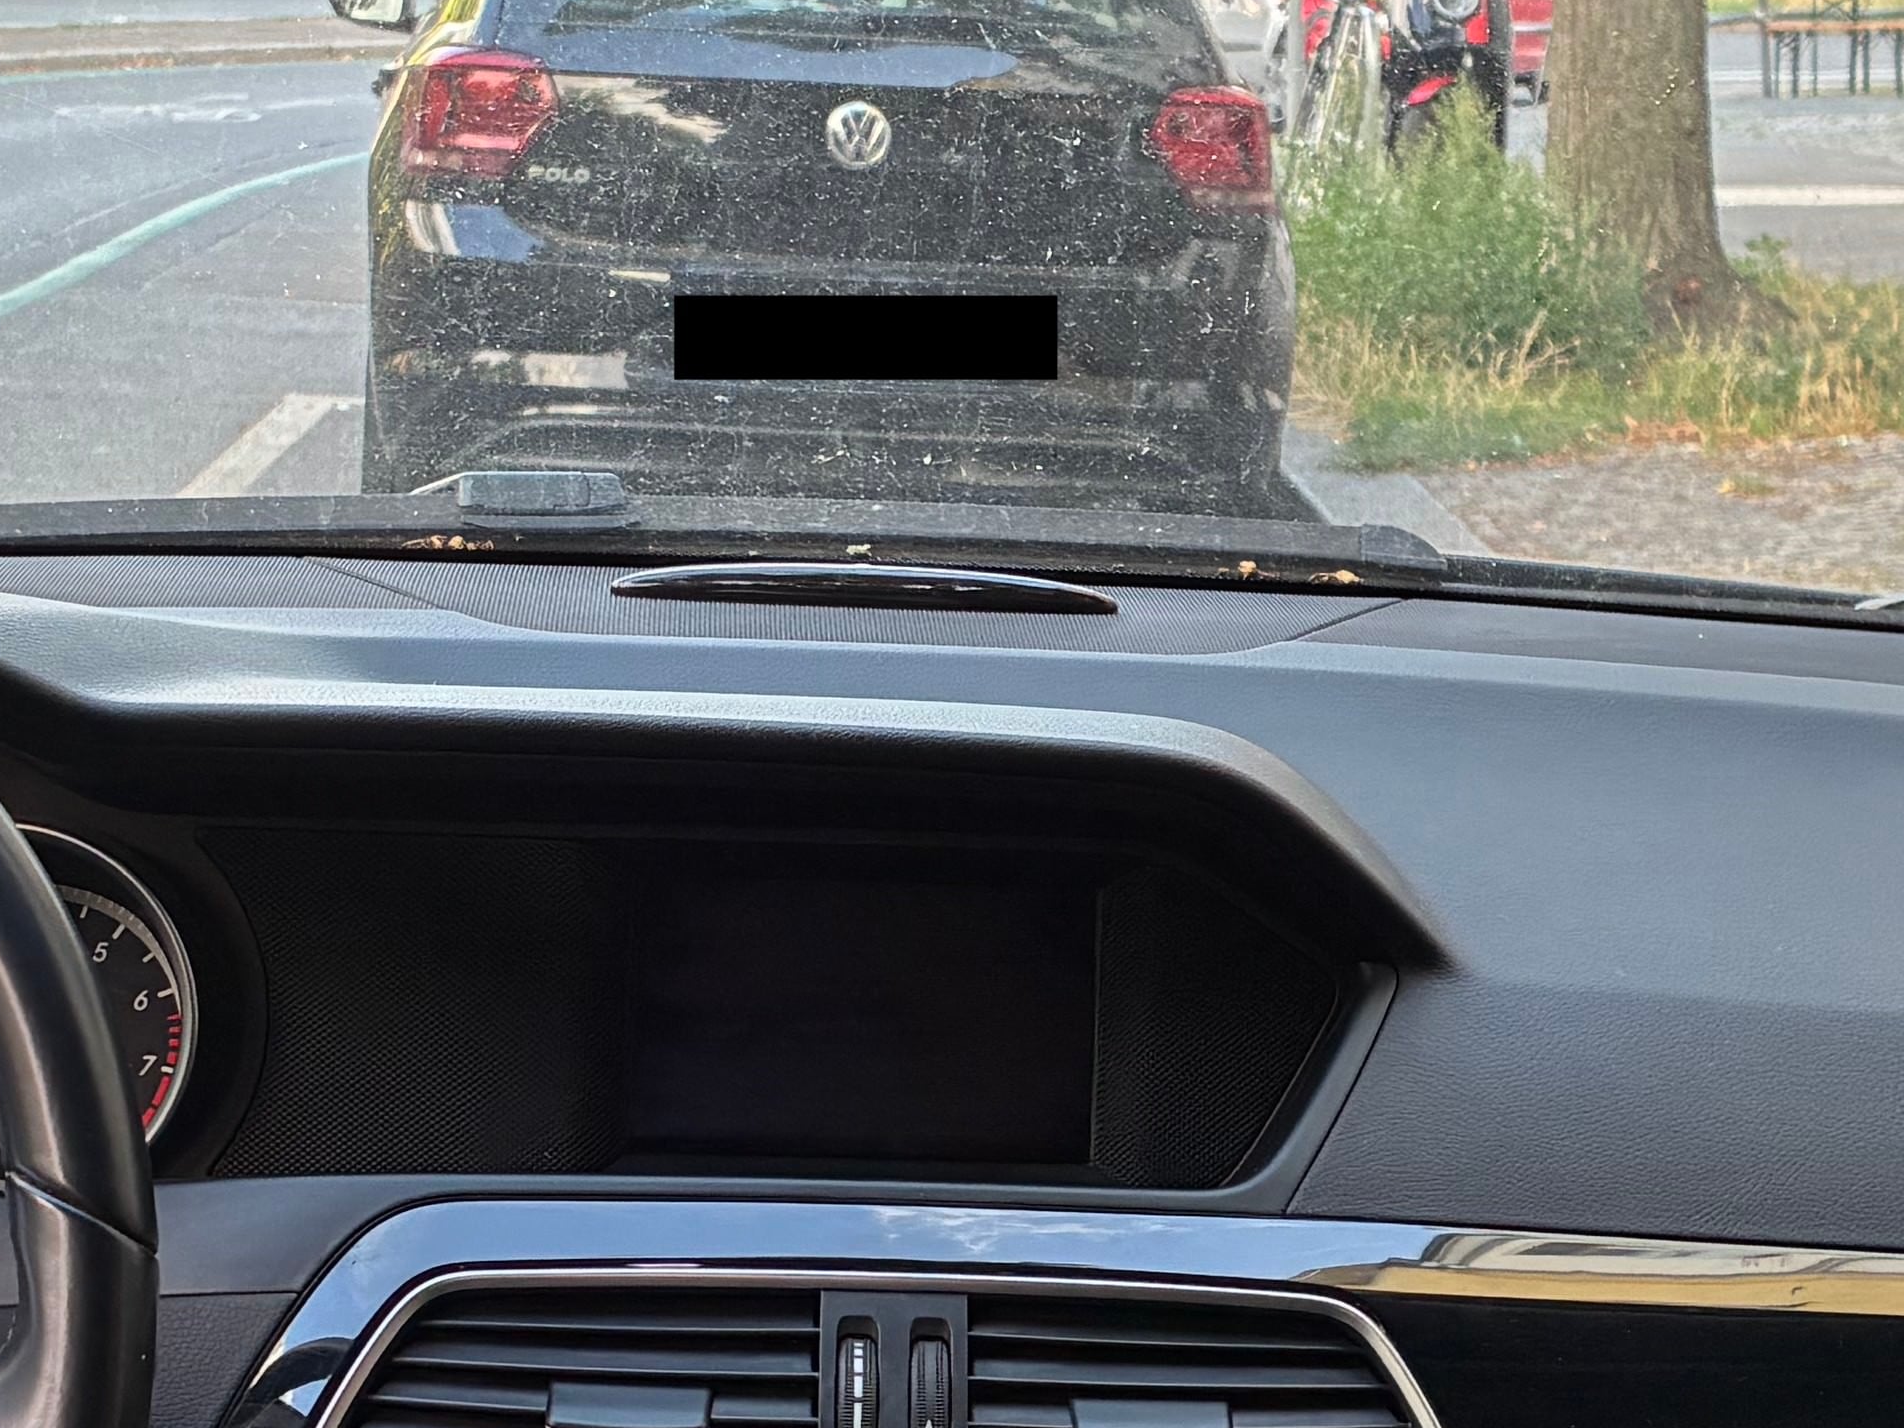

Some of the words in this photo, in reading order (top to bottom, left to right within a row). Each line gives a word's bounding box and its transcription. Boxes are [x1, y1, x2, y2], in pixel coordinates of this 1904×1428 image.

[92, 942, 109, 963] 5
[132, 989, 149, 1012] 6
[138, 1055, 157, 1076] 7
